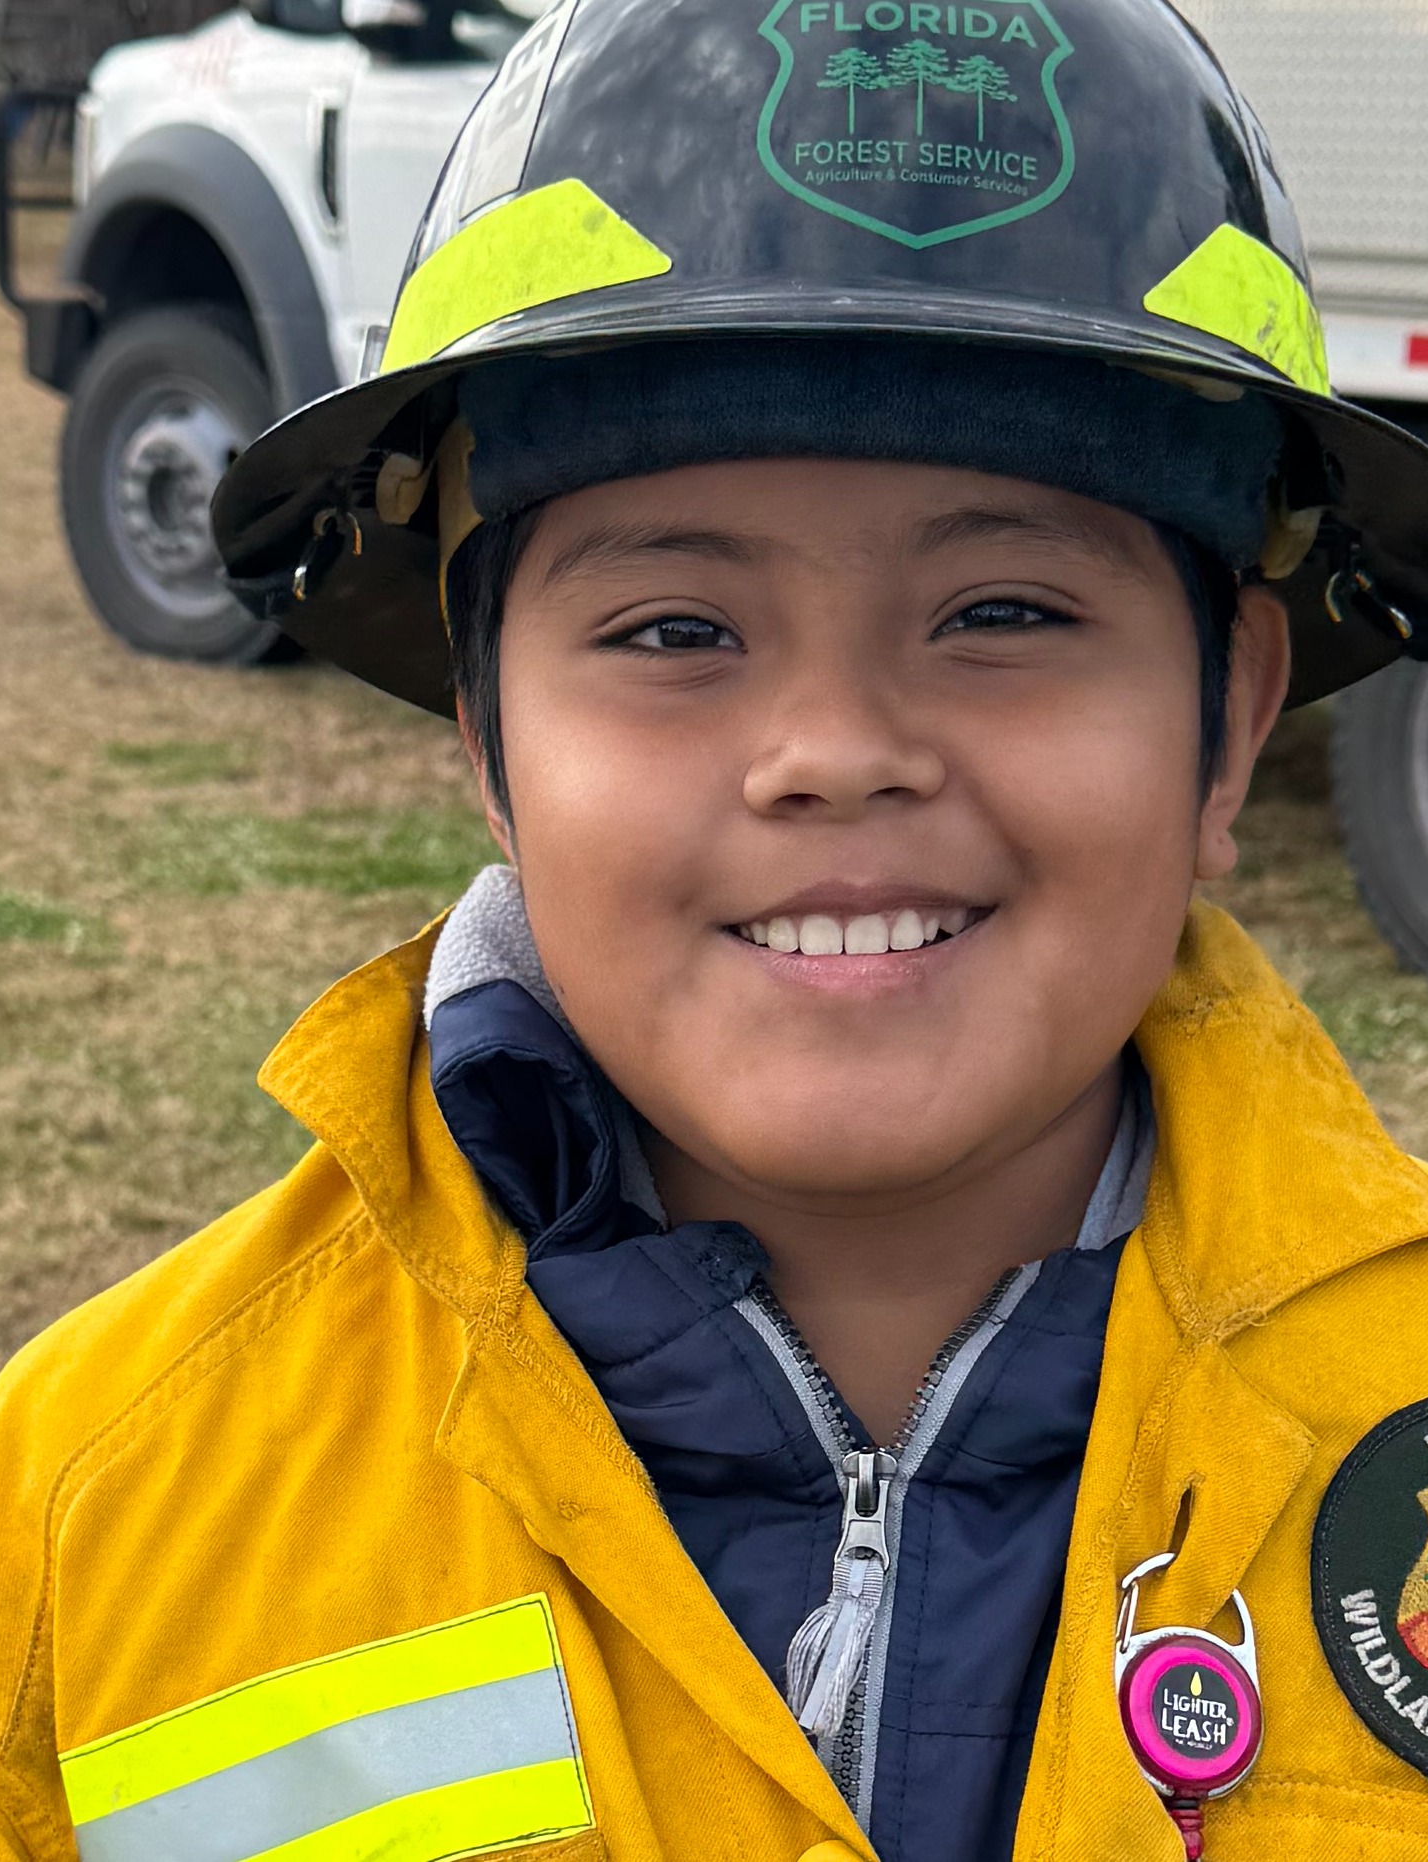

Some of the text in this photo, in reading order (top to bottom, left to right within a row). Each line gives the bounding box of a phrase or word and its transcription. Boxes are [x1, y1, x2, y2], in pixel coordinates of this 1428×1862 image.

[800, 2, 1037, 48] FLORIDA
[794, 139, 1039, 181] FOREST SERVICE
[804, 167, 883, 187] Agriculture
[900, 167, 970, 187] Consumer
[973, 175, 1030, 197] Services
[1164, 1688, 1227, 1719] LIGHTER
[1161, 1707, 1227, 1746] LEASH
